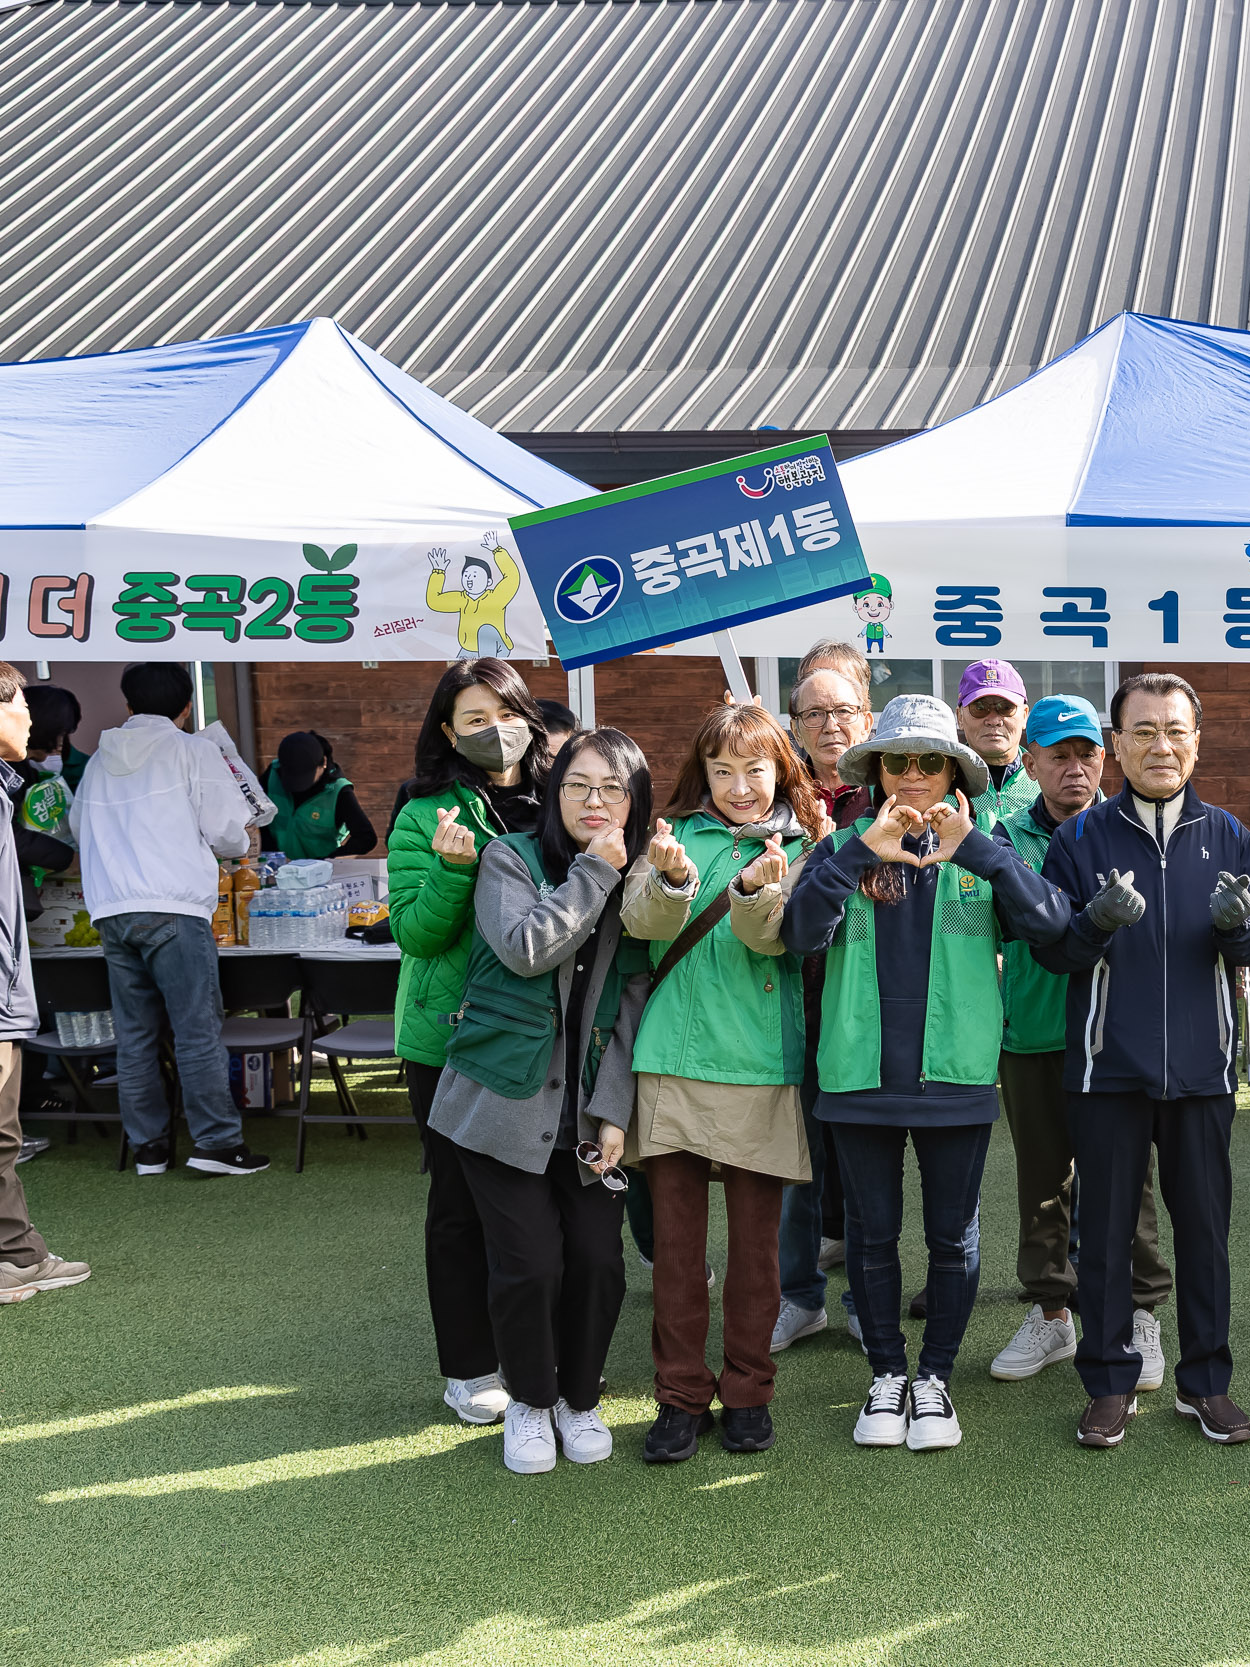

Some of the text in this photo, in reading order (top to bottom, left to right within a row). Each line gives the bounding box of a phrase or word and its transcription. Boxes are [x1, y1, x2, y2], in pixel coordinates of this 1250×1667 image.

[778, 466, 825, 489] 행복광진
[630, 501, 841, 596] 중곡제1동
[28, 572, 95, 643] 더
[112, 571, 360, 643] 중곡2동
[374, 616, 425, 638] 소리질러~
